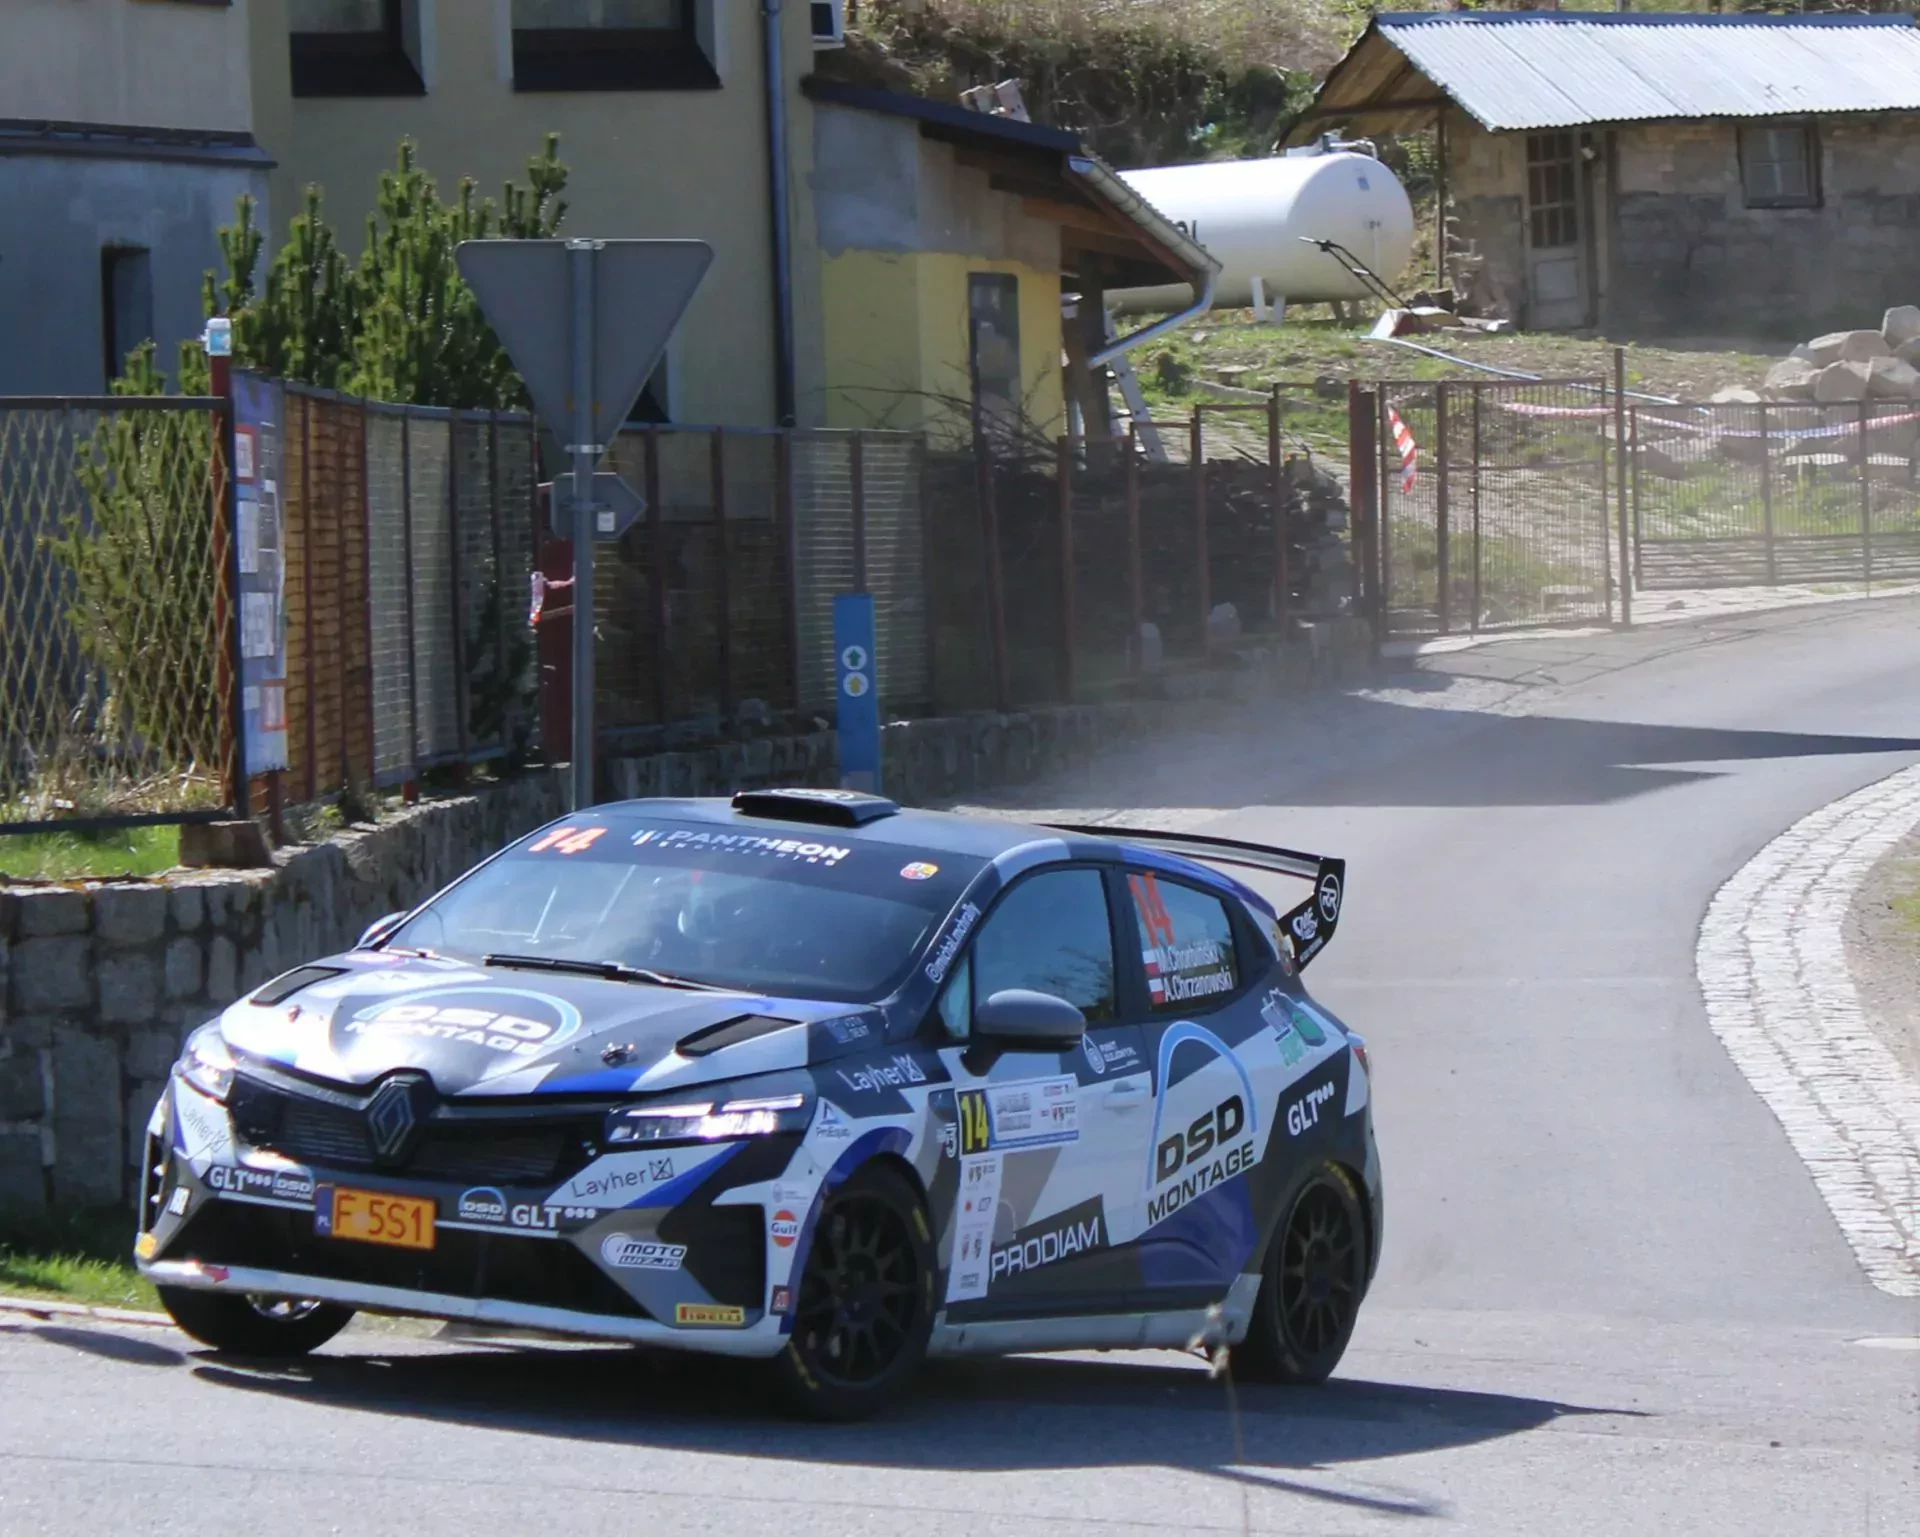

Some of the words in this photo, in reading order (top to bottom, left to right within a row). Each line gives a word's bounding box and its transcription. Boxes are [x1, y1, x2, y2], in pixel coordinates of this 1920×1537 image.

[528, 826, 609, 855] 14
[667, 830, 851, 861] PANTHEON
[1127, 872, 1176, 949] 14
[836, 1063, 907, 1093] Layher
[960, 1093, 989, 1151] 14
[1287, 1090, 1319, 1137] GLT
[1156, 1094, 1245, 1185] DSD
[210, 1166, 248, 1191] GLT
[571, 1168, 647, 1199] Layher
[1147, 1139, 1256, 1226] MONTAGE
[335, 1193, 357, 1231] F
[368, 1199, 422, 1242] 5S1
[511, 1204, 562, 1229] GLT
[771, 1222, 798, 1234] Gulf
[624, 1243, 686, 1257] MOTO
[990, 1216, 1099, 1283] PRODIAM
